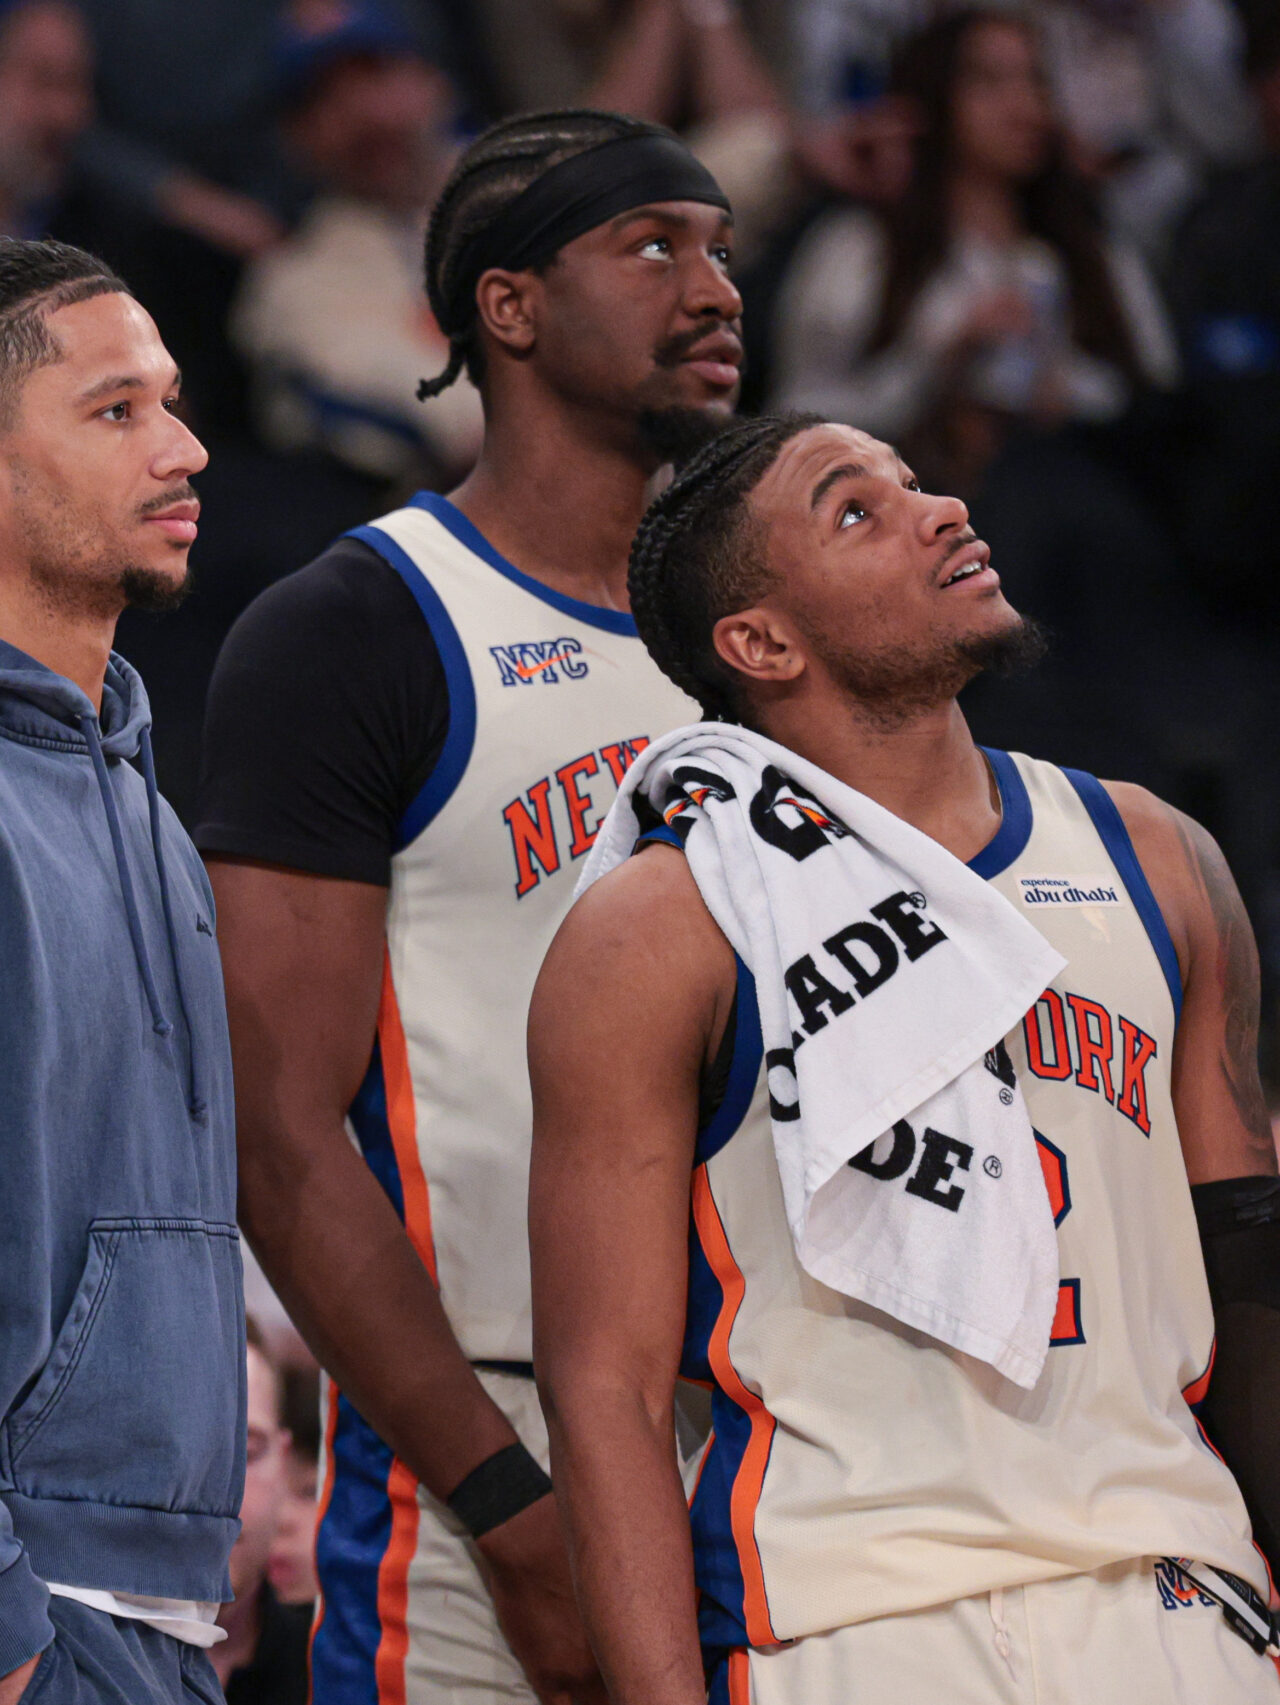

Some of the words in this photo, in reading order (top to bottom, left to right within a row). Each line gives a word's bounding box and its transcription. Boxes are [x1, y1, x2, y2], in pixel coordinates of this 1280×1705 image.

[489, 637, 588, 687] NYC
[1021, 879, 1070, 887] experience
[1024, 888, 1061, 903] abu
[1062, 886, 1119, 903] dhabi
[784, 890, 949, 1050] ADE
